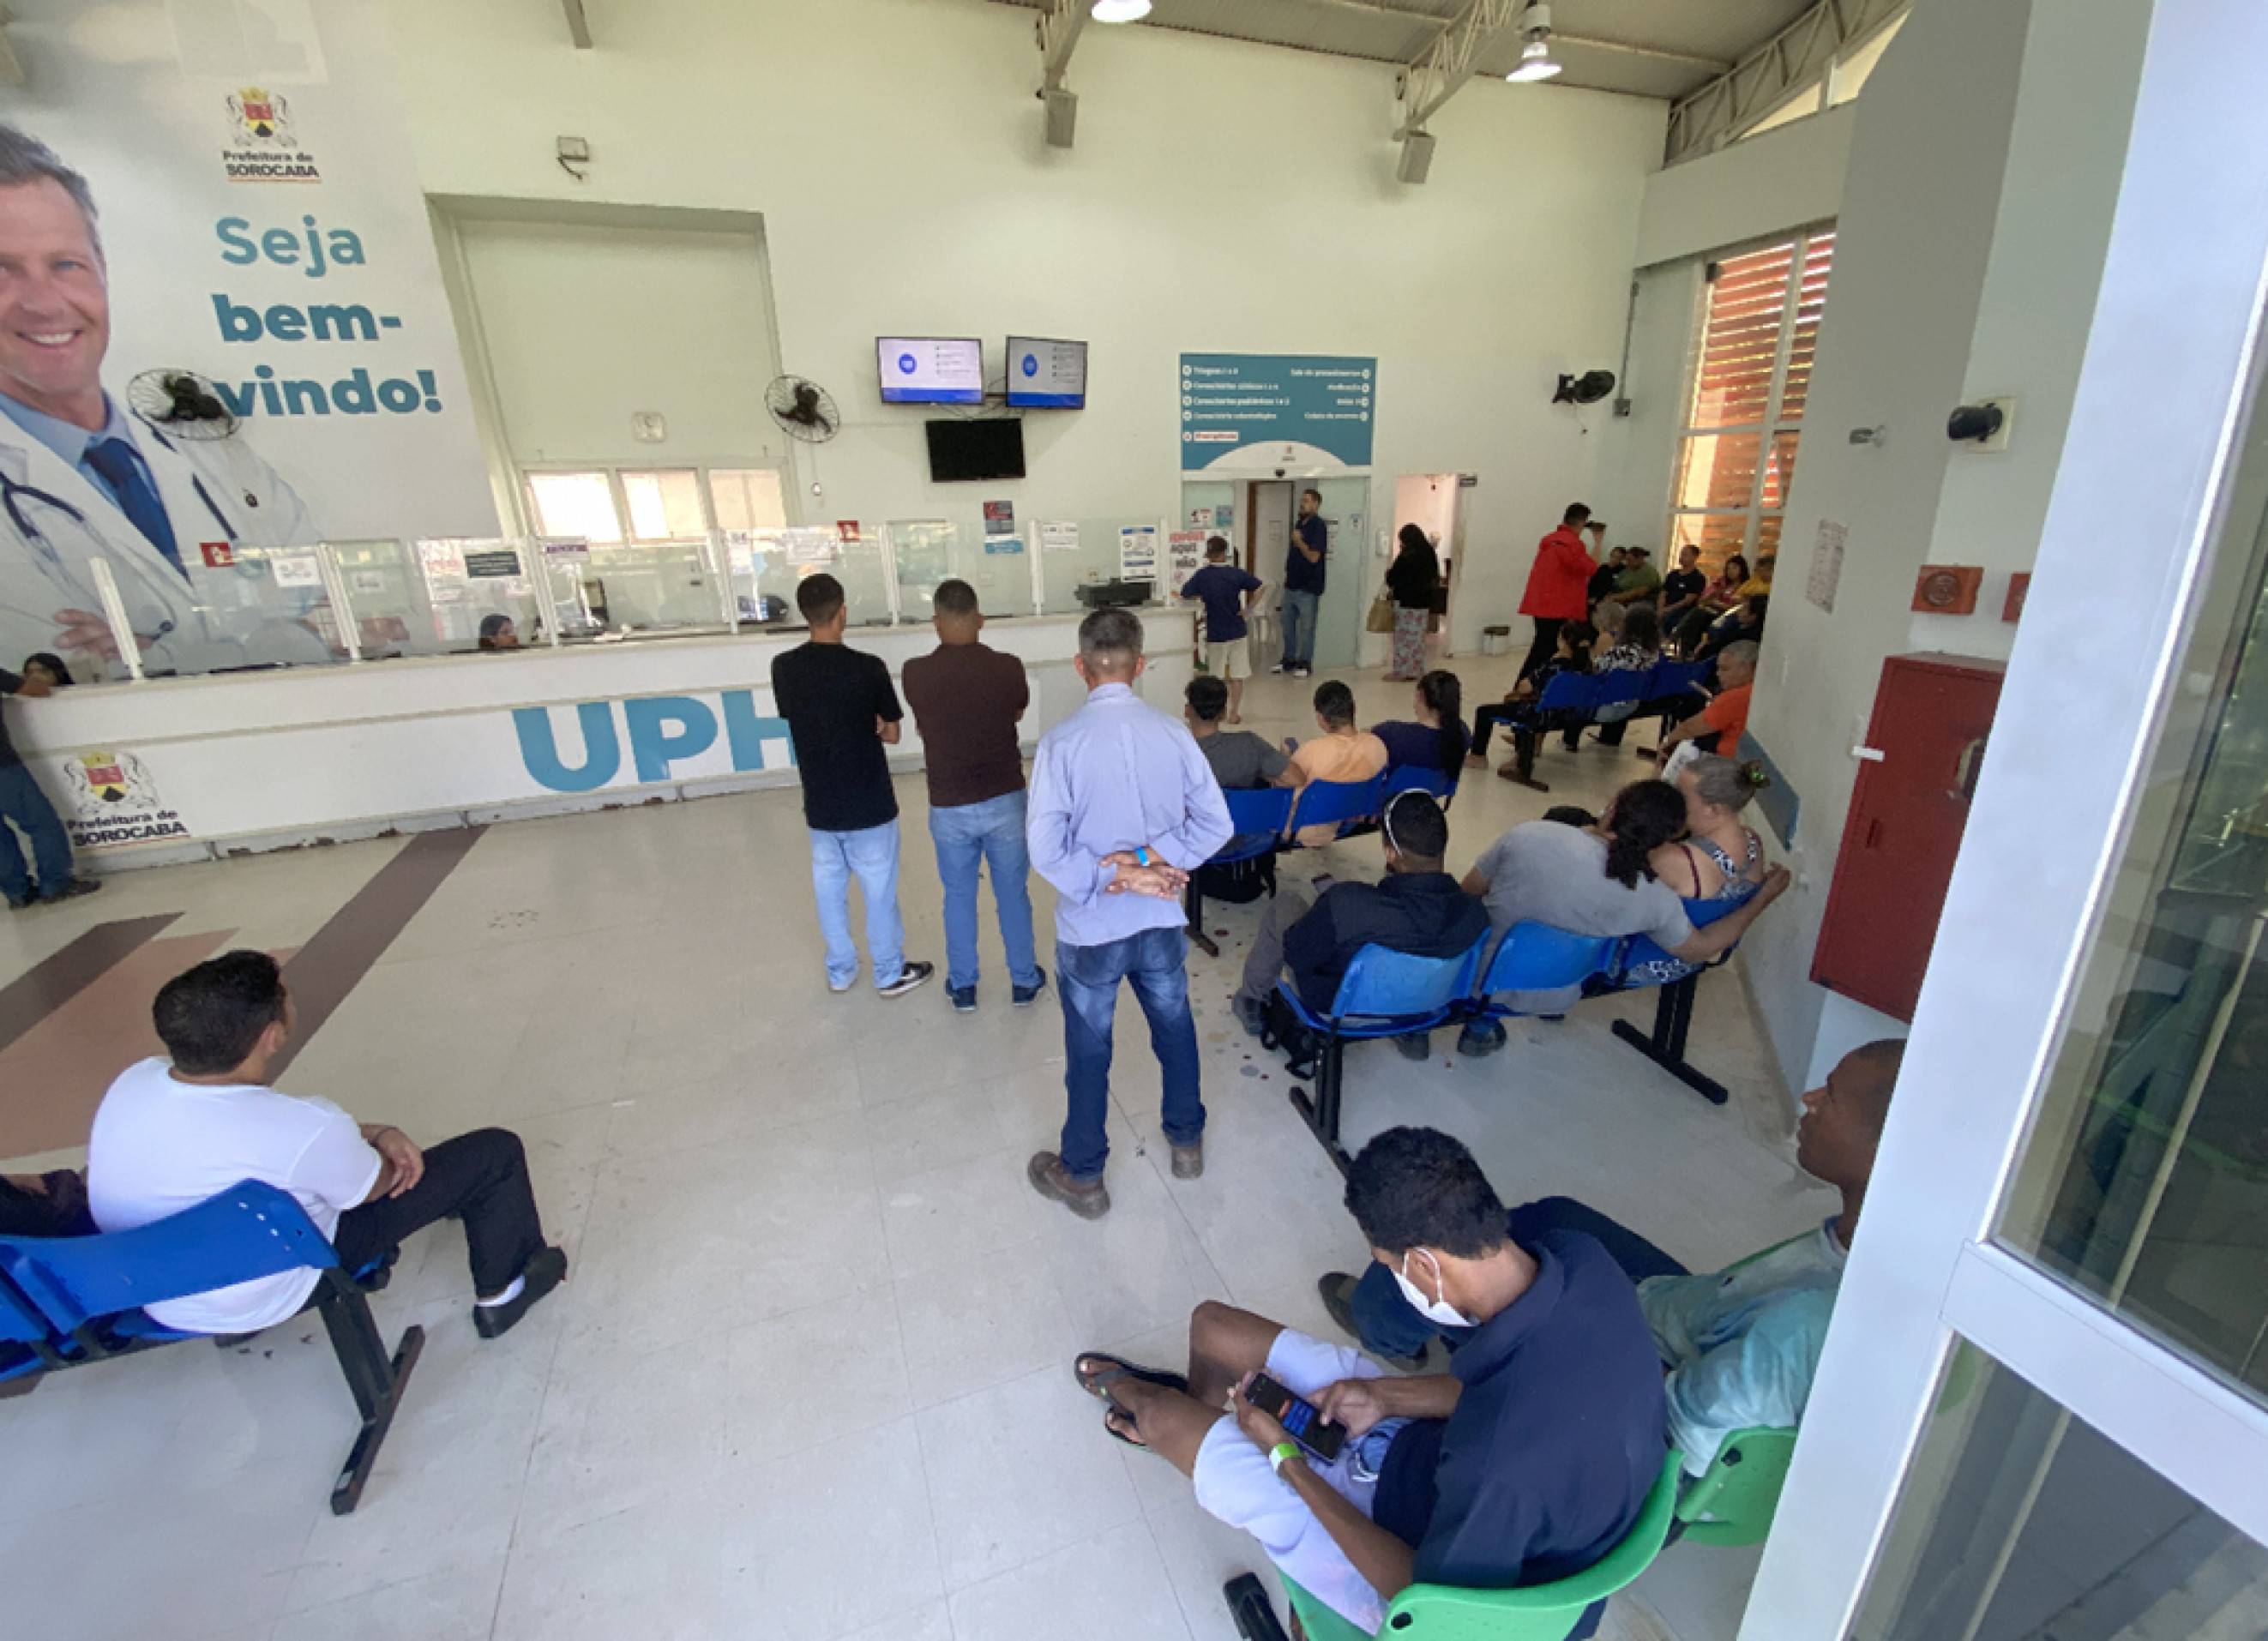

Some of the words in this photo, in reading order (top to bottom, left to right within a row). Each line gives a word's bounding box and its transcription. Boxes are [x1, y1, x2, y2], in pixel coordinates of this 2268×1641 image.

[223, 150, 292, 162] Prefeitura
[296, 152, 313, 162] de
[226, 163, 320, 177] SOROCABA
[216, 214, 365, 278] Seja
[211, 293, 401, 341] bem-
[212, 364, 442, 417] vindo!
[512, 688, 799, 793] UPH
[66, 813, 153, 831] Prefeitura
[156, 809, 178, 820] de
[73, 820, 188, 847] SOROCABA
